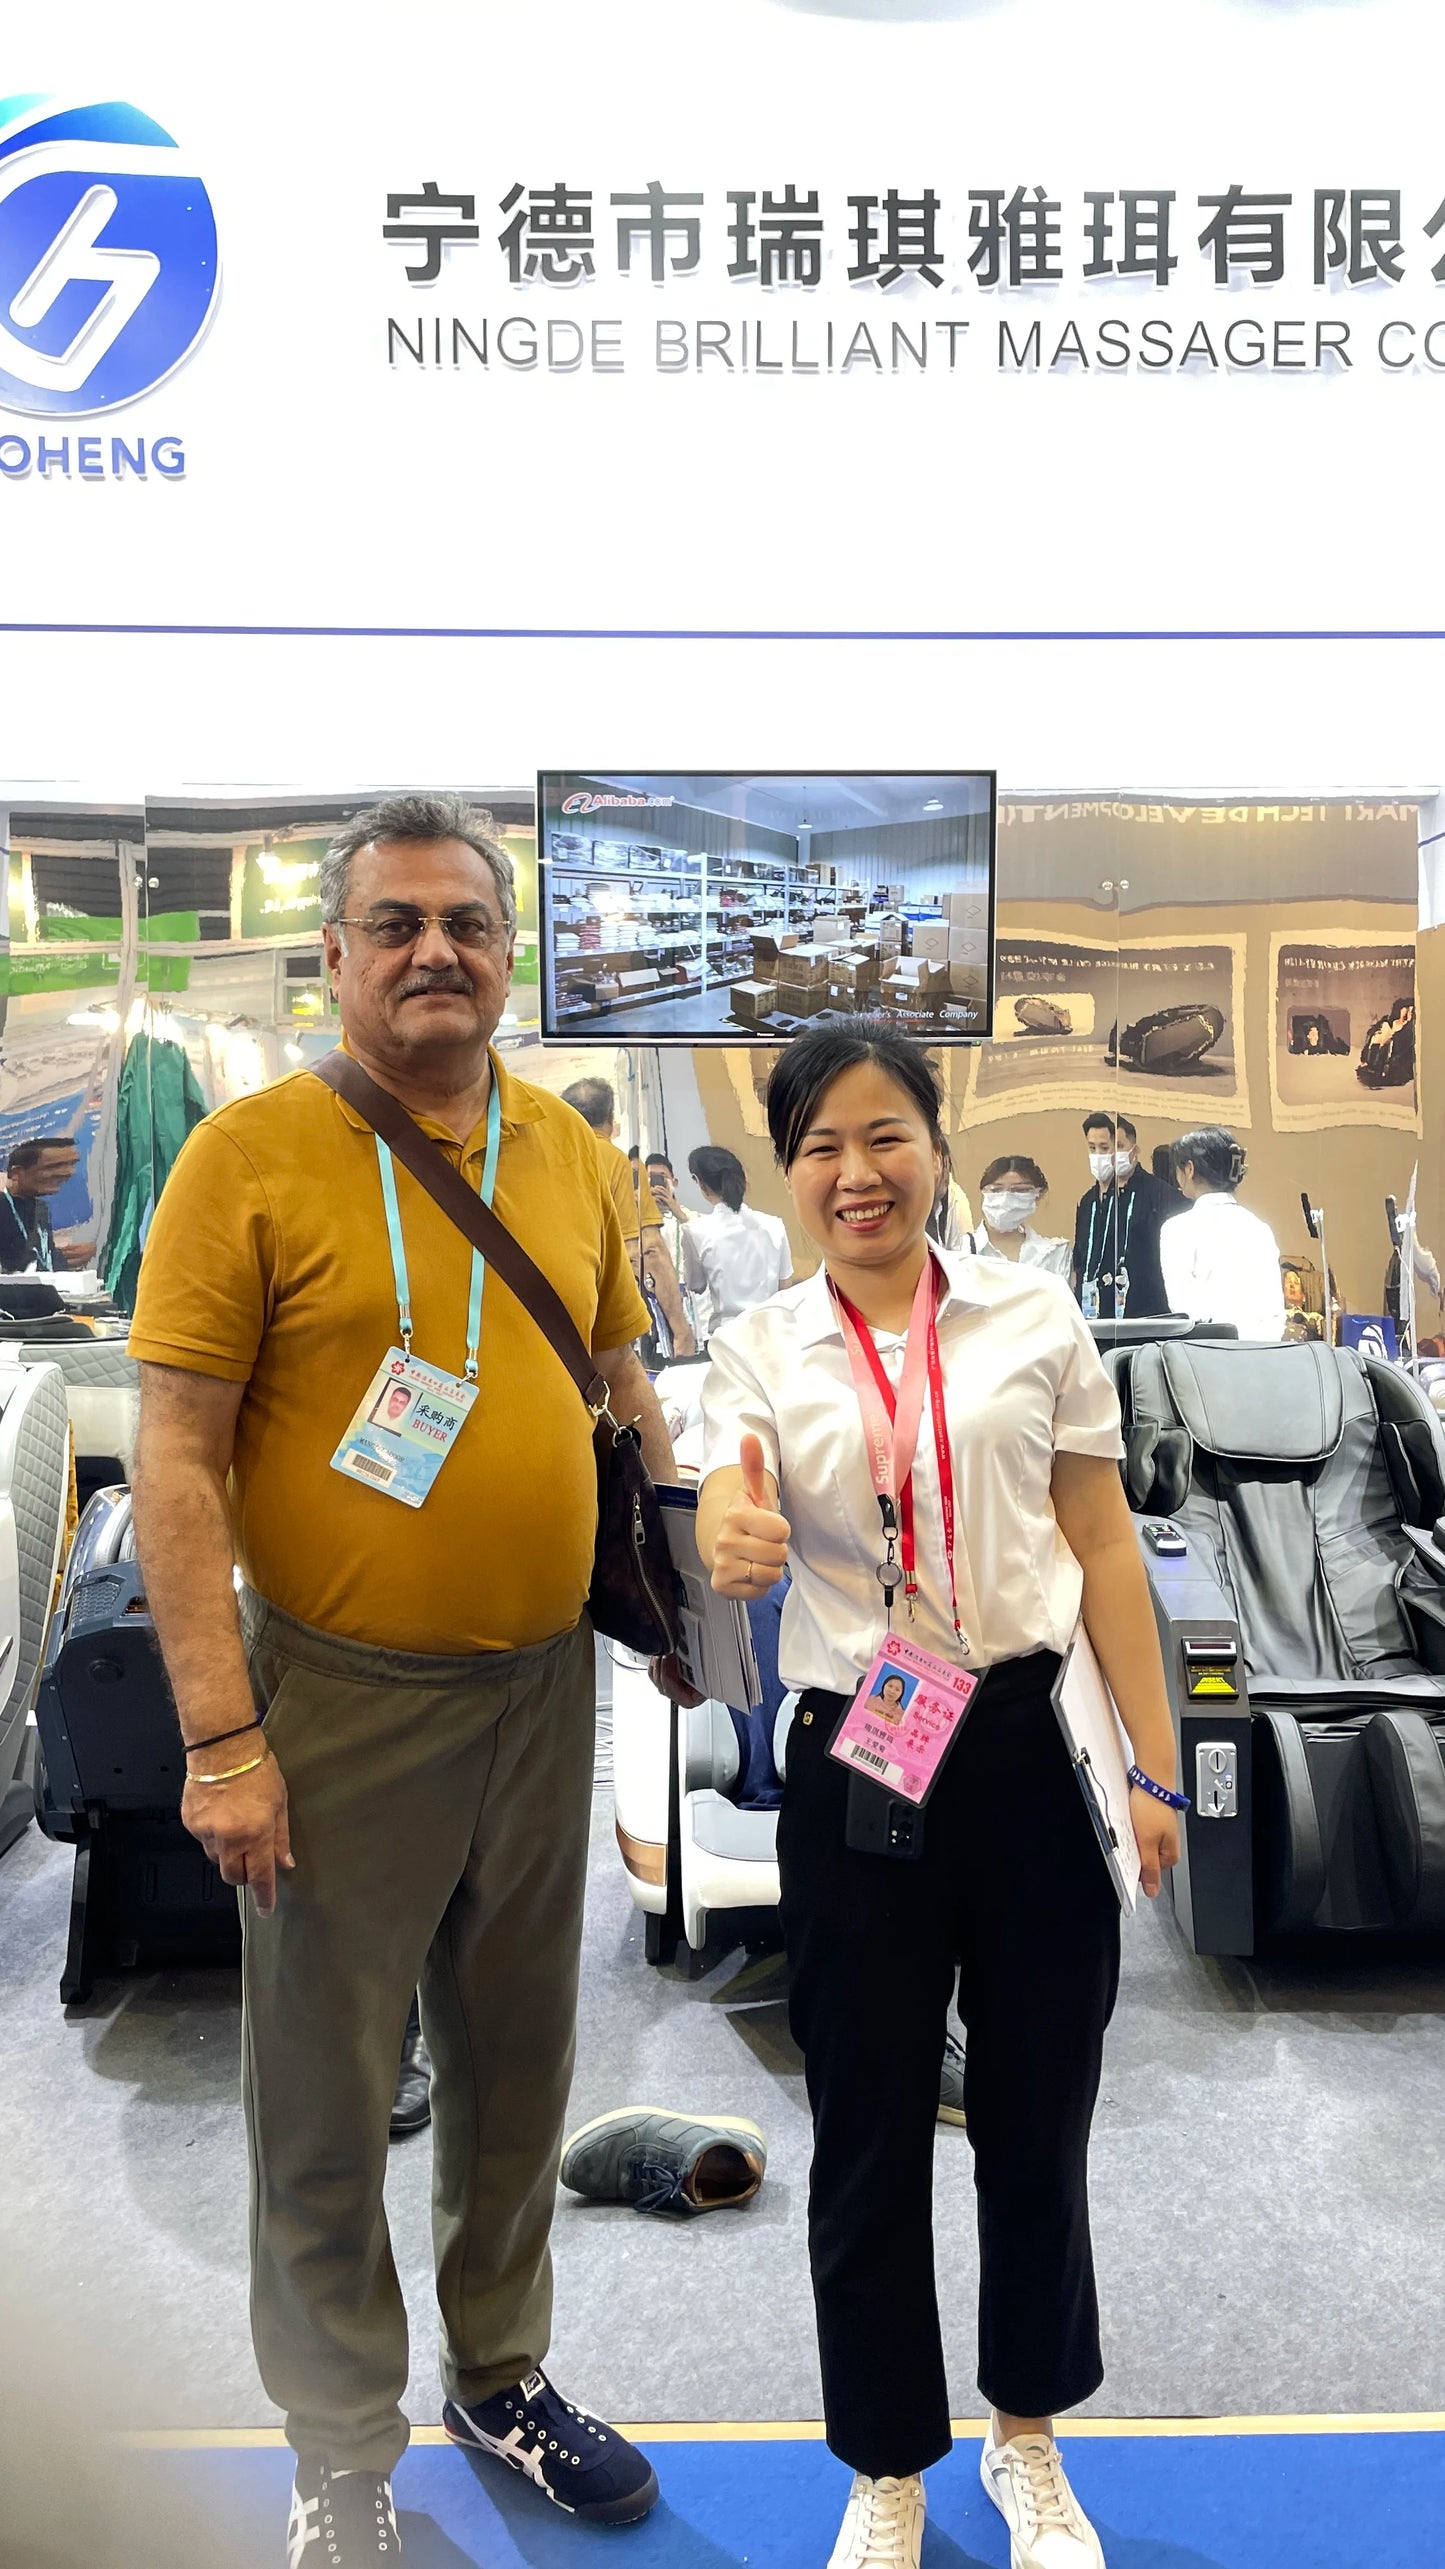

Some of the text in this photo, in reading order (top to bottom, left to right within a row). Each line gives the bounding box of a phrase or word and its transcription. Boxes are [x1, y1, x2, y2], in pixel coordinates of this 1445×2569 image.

[382, 180, 1445, 289] 宁德市瑞琪雅珥有限
[387, 316, 624, 367] NINGDE
[656, 320, 969, 370] BRILLIANT
[998, 319, 1353, 369] MASSAGER
[592, 794, 673, 807] Alibaba.com
[896, 1009, 935, 1019] Associate
[939, 1009, 979, 1020] Company
[412, 1418, 448, 1442] BUYER
[416, 1404, 458, 1431] 采购商
[869, 1413, 889, 1484] Supreme
[953, 1676, 972, 1695] 133
[915, 1694, 954, 1722] 服务证
[913, 1711, 941, 1731] Service
